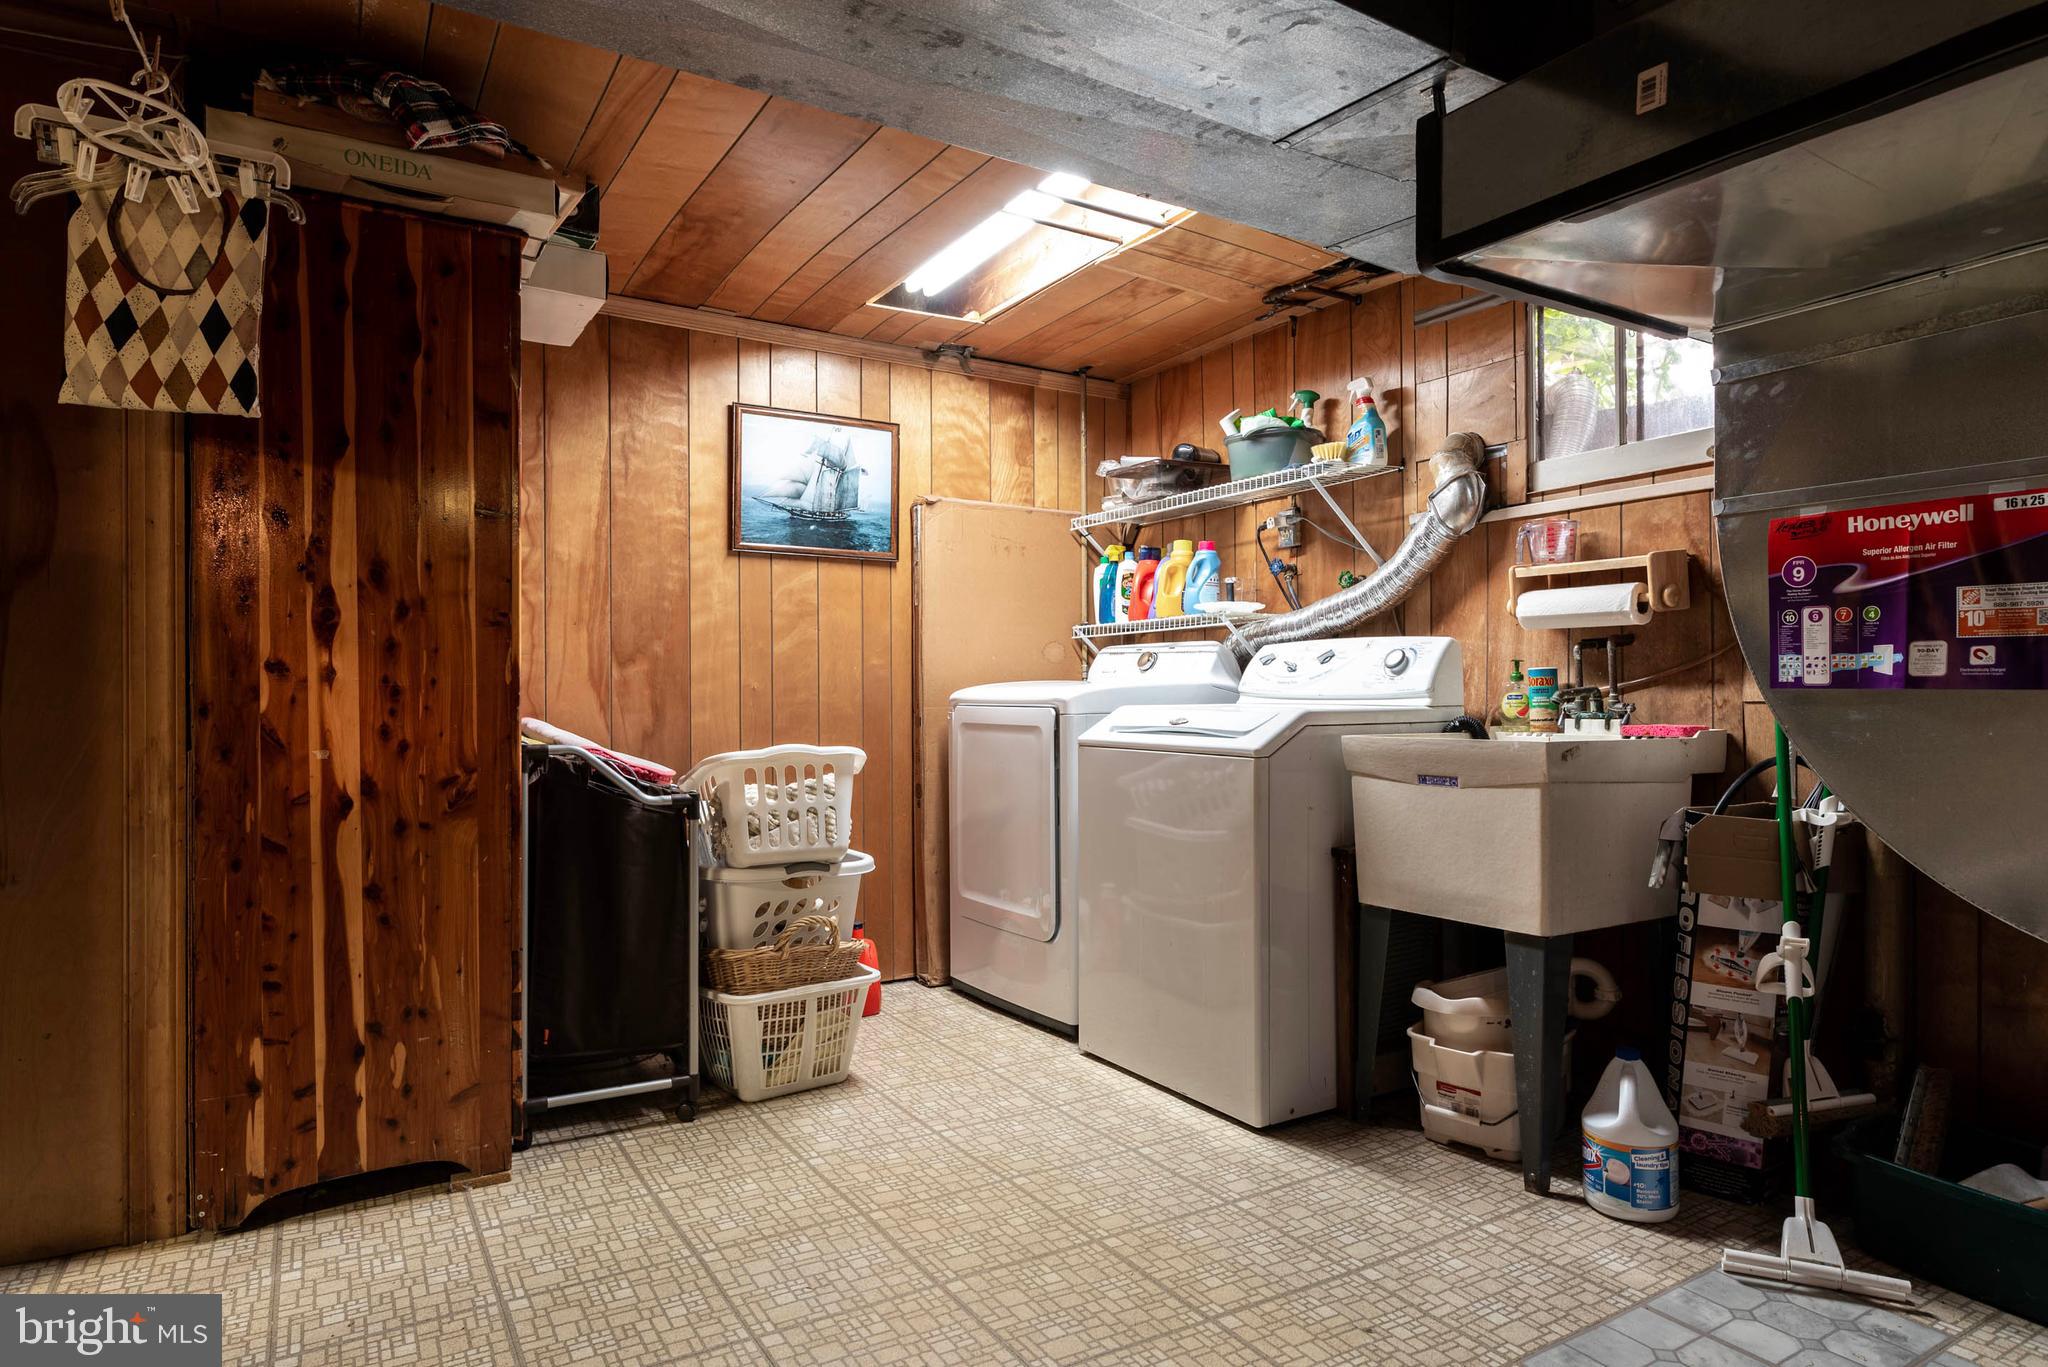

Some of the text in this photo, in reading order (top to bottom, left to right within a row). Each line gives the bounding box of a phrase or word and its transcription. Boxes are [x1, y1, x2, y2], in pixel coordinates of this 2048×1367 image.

[343, 148, 433, 181] ONEIDA
[2004, 495, 2045, 509] 16 x 25
[1847, 503, 1974, 534] Honeywell
[1862, 546, 1892, 557] Superior
[1893, 544, 1923, 555] Allergen
[1925, 542, 1936, 551] Air
[1937, 541, 1958, 550] Filter
[1792, 567, 1805, 582] 9
[1812, 612, 1819, 621] 9
[1840, 611, 1847, 619] 7
[1868, 610, 1875, 619] 4
[1633, 1154, 1660, 1162] Cleaning
